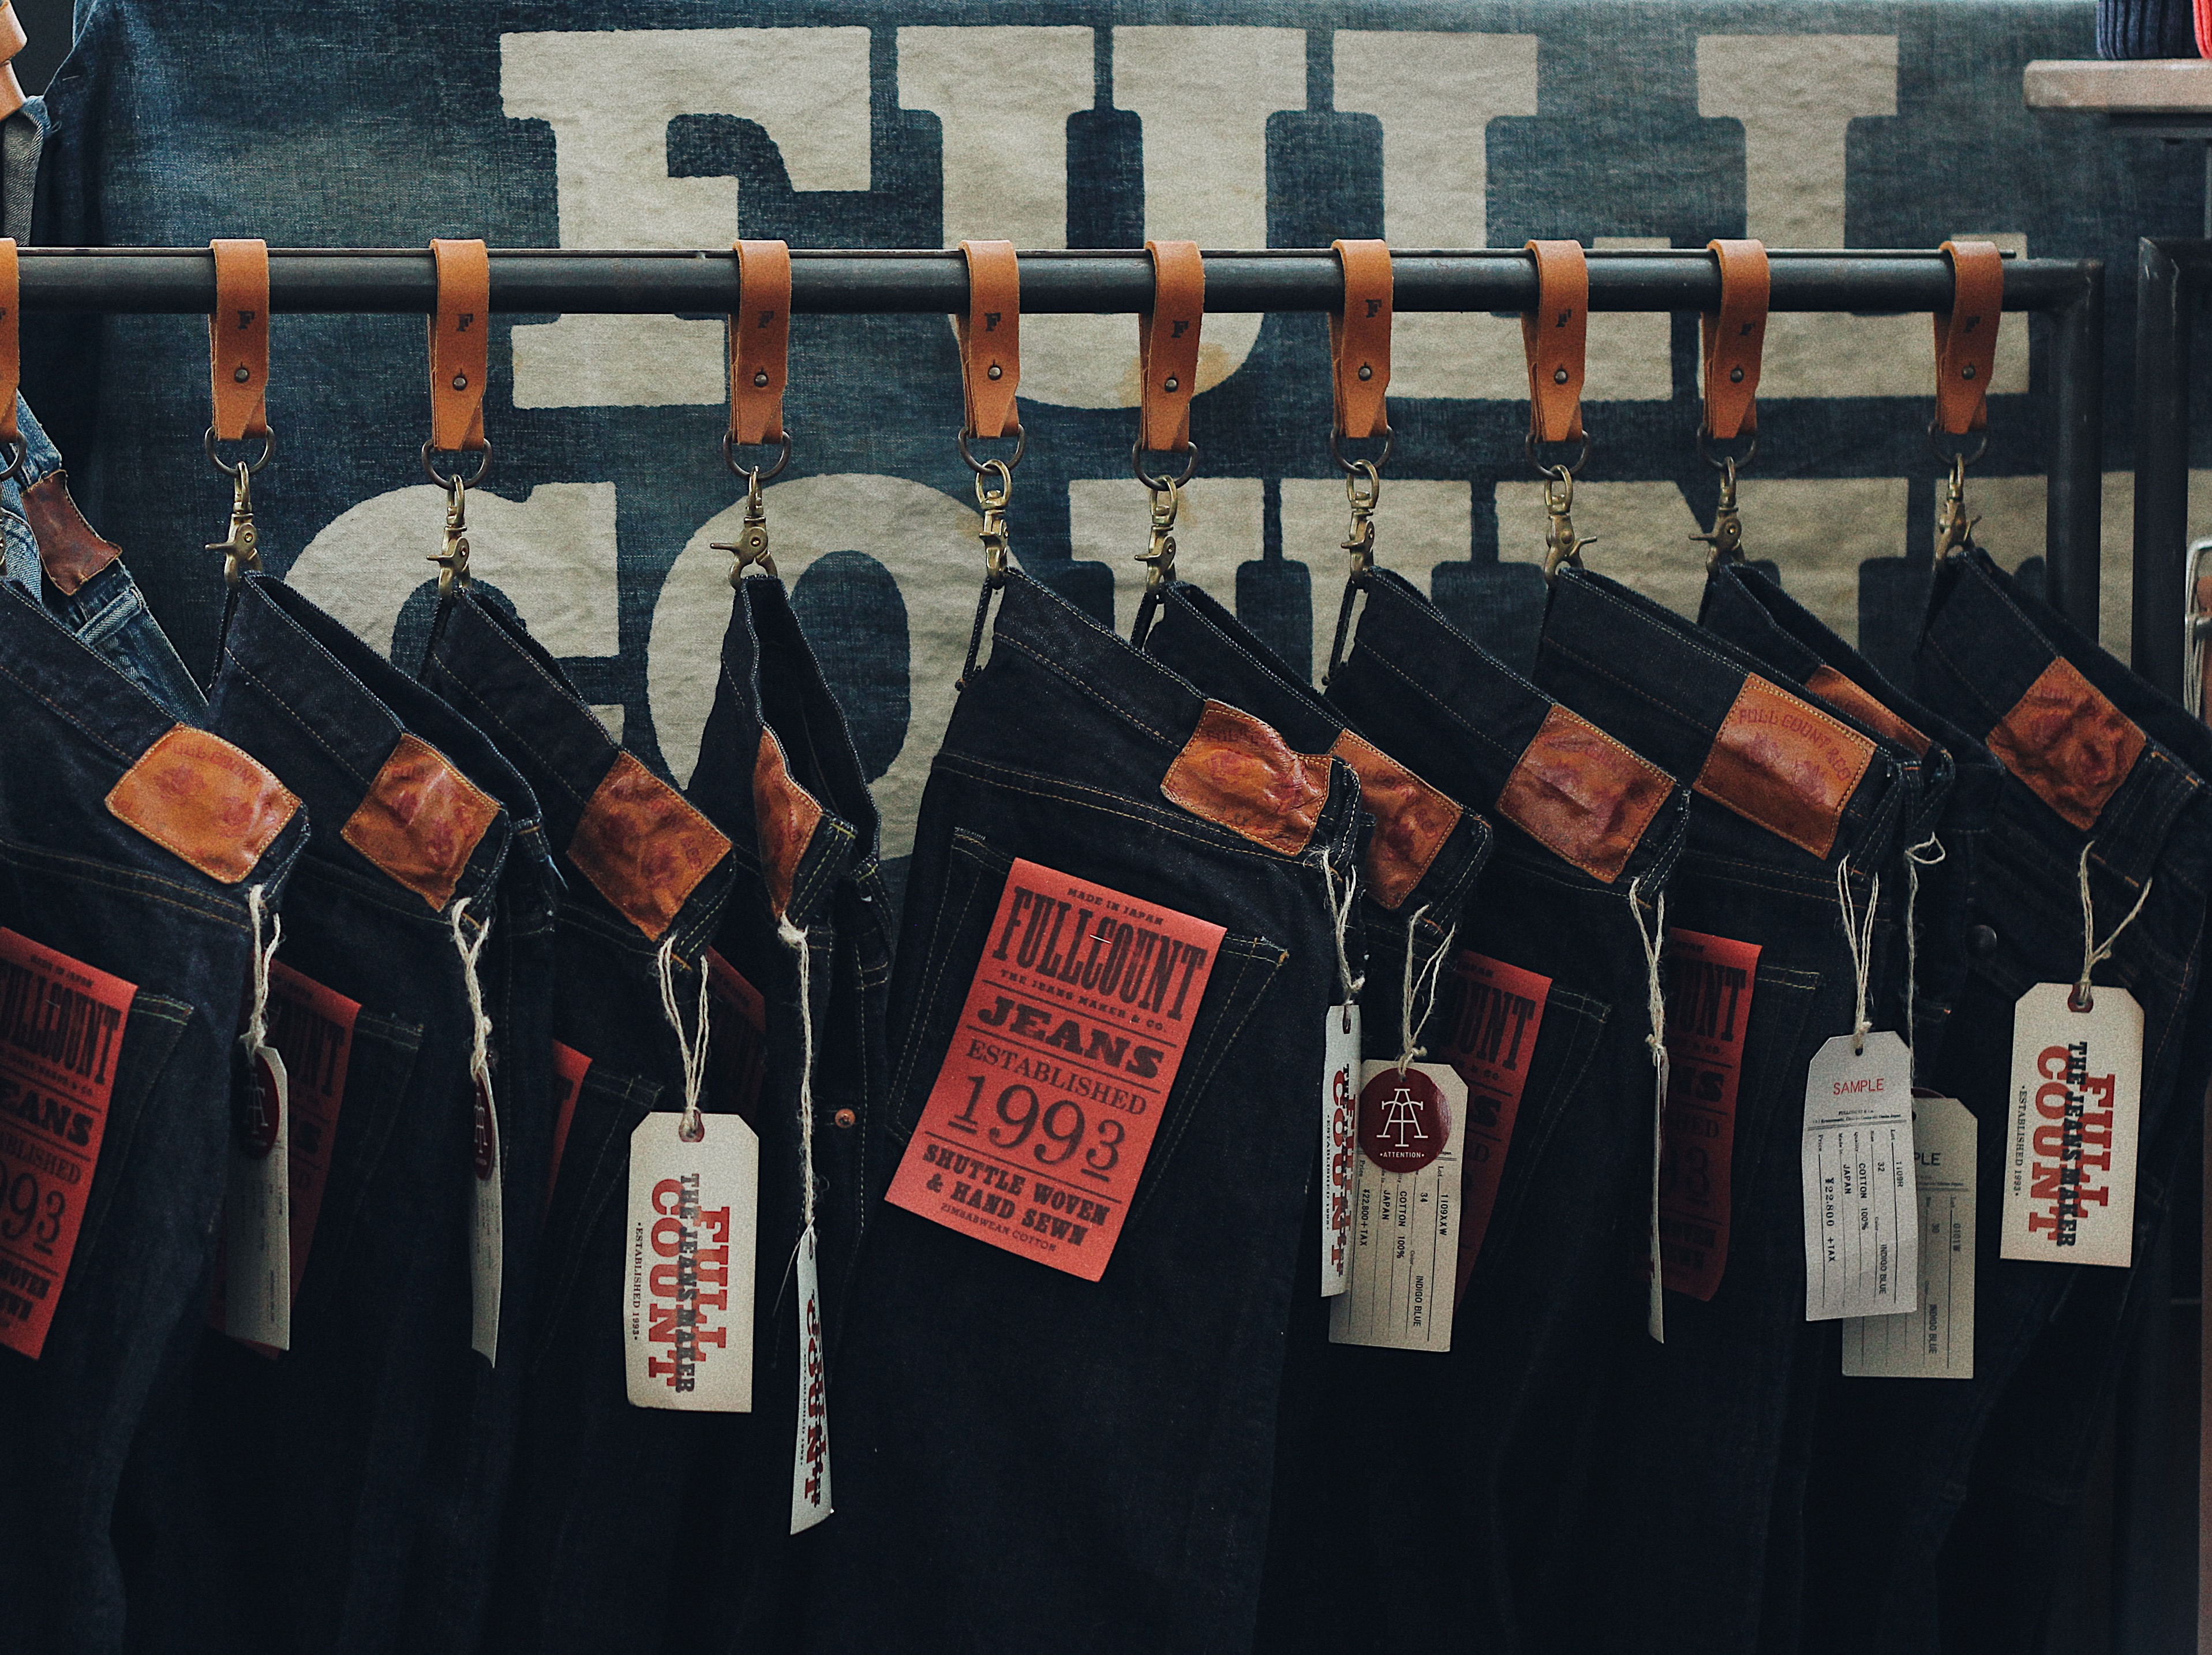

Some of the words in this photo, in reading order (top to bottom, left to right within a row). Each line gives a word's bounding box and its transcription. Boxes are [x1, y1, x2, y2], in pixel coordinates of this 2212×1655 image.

[500, 25, 2029, 410] FULL
[1068, 888, 1103, 905] MADE
[1106, 901, 1120, 912] IN
[1124, 906, 1164, 925] JAPAN
[991, 886, 1208, 1021] FULLCOUNT
[1001, 969, 1027, 984] THE
[1032, 981, 1073, 1000] JEANS
[1079, 996, 1126, 1018] MAKER
[977, 995, 1165, 1079] JEANS
[2066, 1041, 2087, 1085] THE
[0, 1076, 93, 1147] EANS
[965, 1038, 1147, 1115] ESTABLISHED
[1833, 1078, 1885, 1096] SAMPLE
[950, 1075, 1125, 1175] 1993
[2015, 1090, 2027, 1166] ESTABLISHED
[2028, 1045, 2073, 1240] COUNT
[2062, 1090, 2084, 1161] JEANS
[2073, 1073, 2116, 1218] FULL
[680, 1174, 699, 1219] THE
[923, 1144, 1026, 1196] SHUTTLE
[1034, 1182, 1110, 1225] WOVEN
[1332, 1070, 1345, 1272] COUNT
[1420, 1192, 1428, 1202] 34
[1843, 1164, 1852, 1194] JAPAN
[1858, 1163, 1867, 1199] COTTON
[1877, 1161, 1885, 1172] 32
[926, 1173, 944, 1193] &
[950, 1180, 1015, 1219] HAND
[1021, 1208, 1088, 1246] SEWN
[941, 1202, 1010, 1235] ZIMBABWEAN
[1012, 1230, 1057, 1252] COTTON
[1382, 1190, 1391, 1220] JAPAN
[1398, 1191, 1408, 1227] COTTON
[1861, 1207, 1869, 1231] 100%
[2056, 1168, 2080, 1246] MAKER
[632, 1227, 643, 1309] ESTABLISHED
[678, 1226, 698, 1302] JEANS
[1397, 1235, 1405, 1258] 100%
[1827, 1236, 1836, 1262] +TAX
[648, 1179, 686, 1386] COUNT
[692, 1206, 730, 1361] FULL
[1413, 1305, 1423, 1327] BLUE
[1414, 1275, 1424, 1303] INDIGO
[1879, 1273, 1887, 1295] BLUE
[675, 1304, 697, 1392] MAKER
[1928, 1333, 1937, 1354] BLUE
[804, 1299, 818, 1504] COUNT
